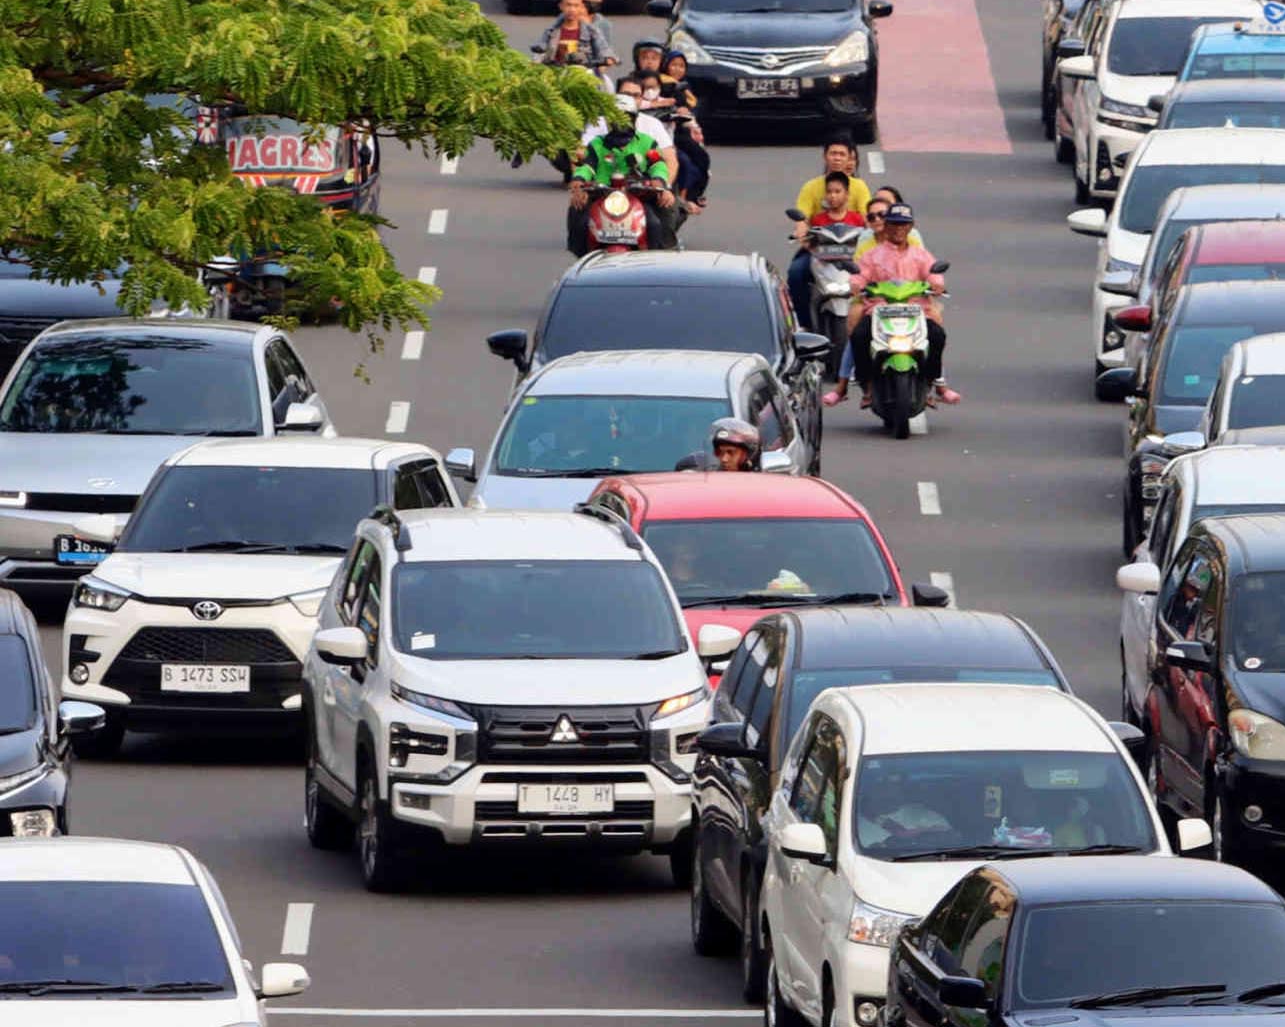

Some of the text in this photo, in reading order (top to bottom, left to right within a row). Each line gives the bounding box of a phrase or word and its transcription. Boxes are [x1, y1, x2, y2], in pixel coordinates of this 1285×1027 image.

[60, 538, 70, 552] B
[163, 667, 173, 682] B
[180, 667, 214, 683] 1473
[521, 785, 529, 803] T
[545, 786, 579, 803] 1448
